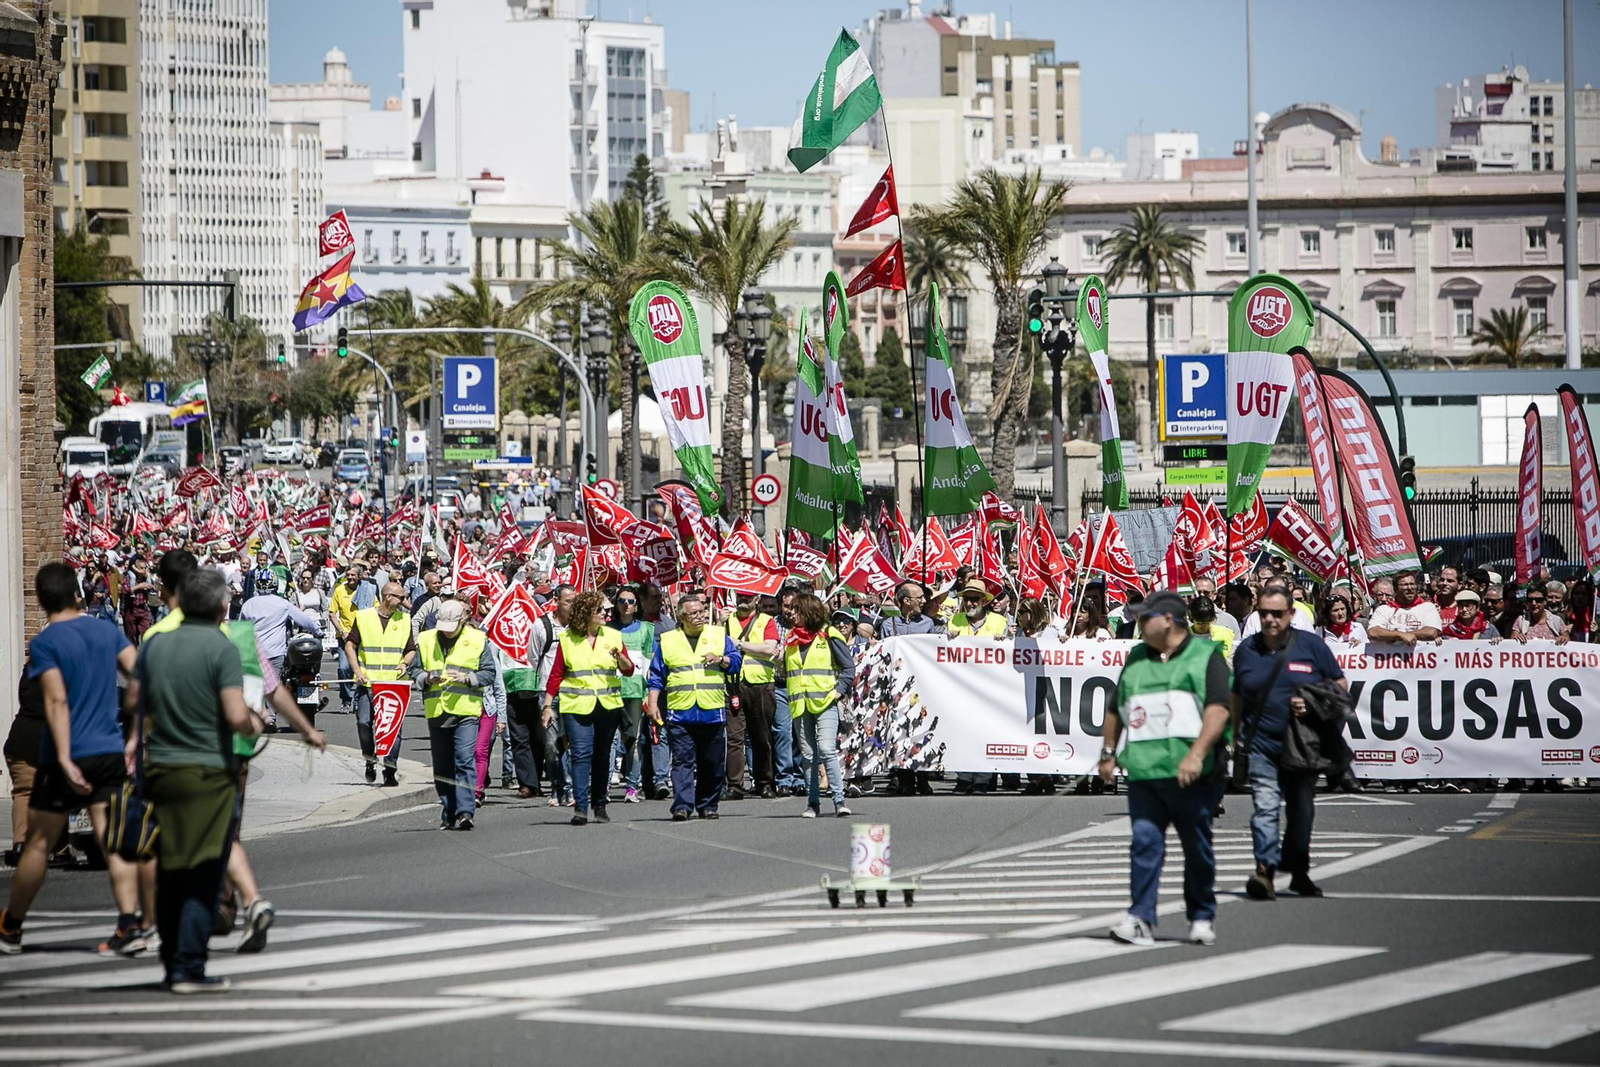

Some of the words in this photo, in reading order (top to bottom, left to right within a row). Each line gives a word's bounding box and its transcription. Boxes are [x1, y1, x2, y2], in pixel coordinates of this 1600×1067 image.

[1253, 295, 1287, 314] UGT
[150, 383, 161, 399] P
[457, 363, 482, 399] P
[1181, 361, 1210, 403] P
[453, 403, 487, 413] Canalejas
[1236, 381, 1288, 419] UGT
[800, 399, 829, 443] UG
[1177, 407, 1217, 418] Canalejas
[1183, 448, 1208, 458] LIBRE
[757, 484, 774, 494] 40
[794, 487, 843, 514] Andaluca
[1276, 504, 1337, 570] CCOO
[1296, 548, 1326, 578] Cádiz
[936, 646, 1006, 666] EMPLEO
[1012, 647, 1084, 667] ESTABLE
[1374, 651, 1437, 670] DIGNAS
[1455, 648, 1493, 669] MÁS
[1499, 650, 1600, 669] PROTECCIÓ
[1035, 676, 1118, 737] NO
[1342, 677, 1584, 741] XCUSAS
[987, 745, 1018, 754] CCOO
[1355, 752, 1386, 760] CCOO
[1543, 751, 1574, 759] CCOO
